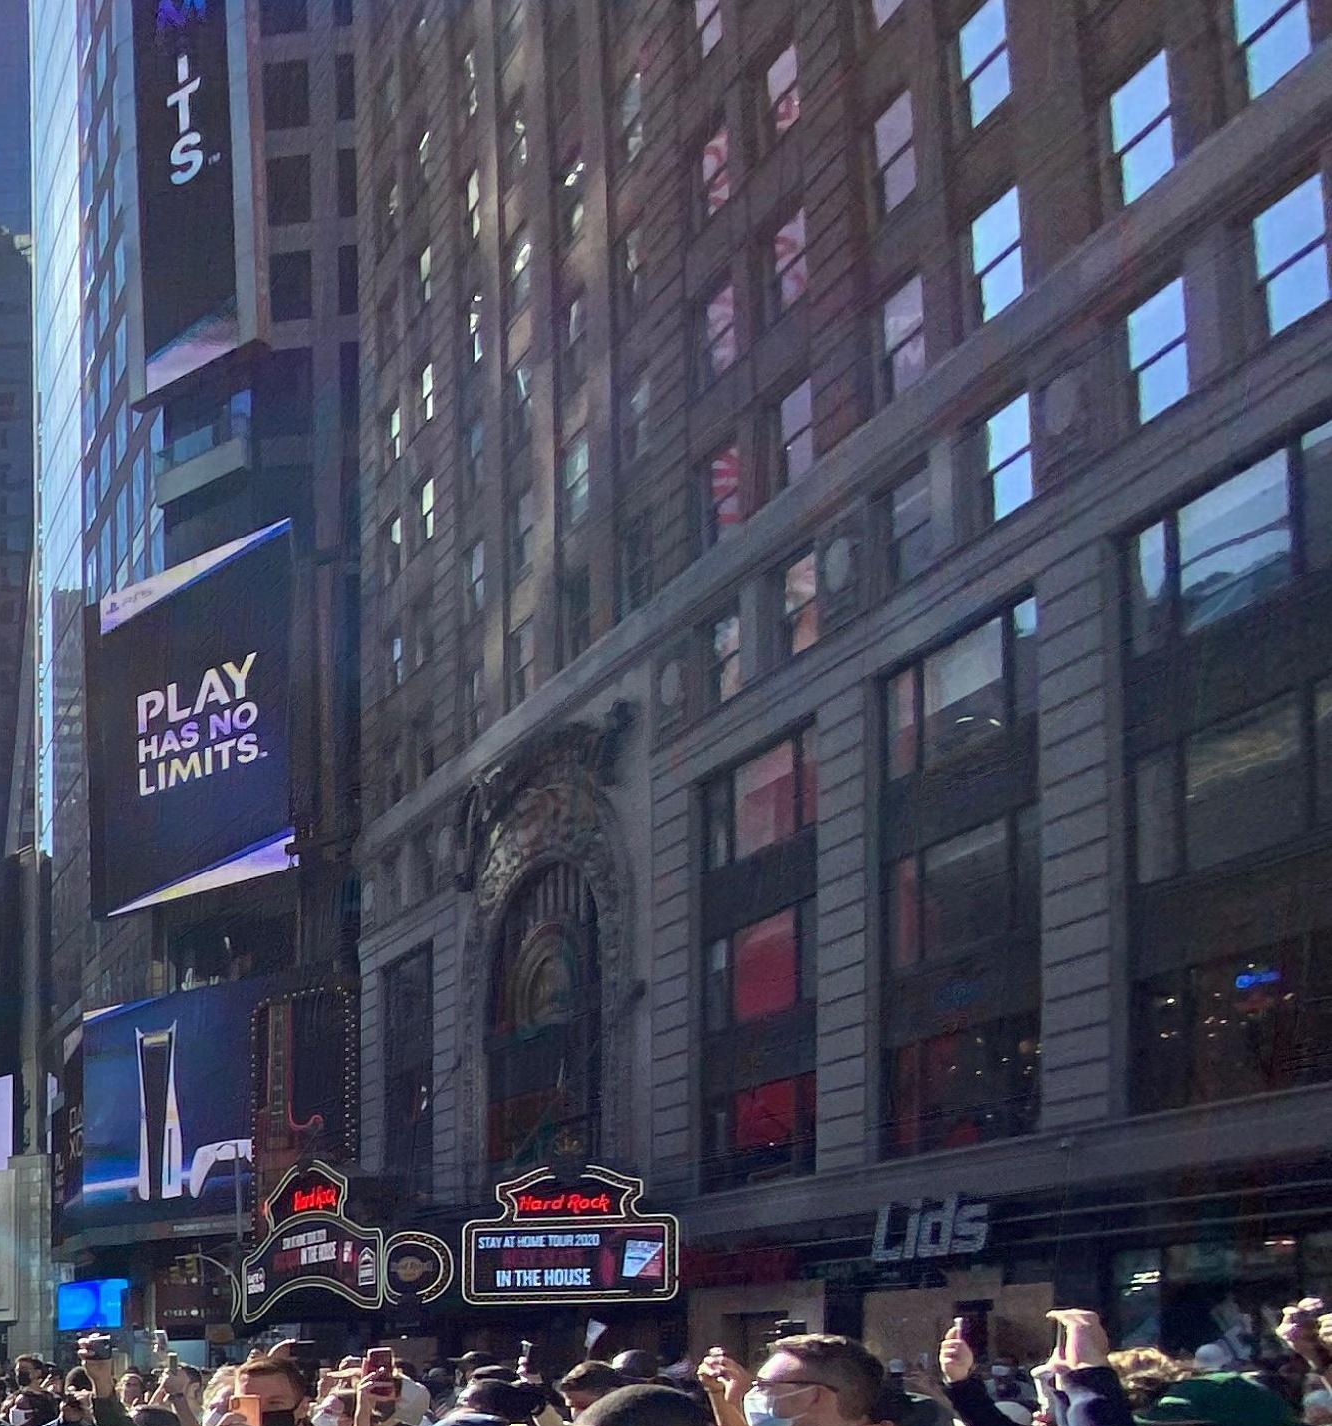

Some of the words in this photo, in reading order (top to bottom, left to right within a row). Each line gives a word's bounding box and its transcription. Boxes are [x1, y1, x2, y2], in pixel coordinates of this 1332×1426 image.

[137, 651, 257, 735] PLAY
[138, 720, 200, 763] HAS
[209, 701, 259, 741] NO
[518, 1193, 565, 1211] Hard
[567, 1192, 611, 1214] Rock
[477, 1236, 503, 1249] STAY
[503, 1236, 516, 1248] AT
[547, 1234, 574, 1247] TOUR
[574, 1233, 600, 1247] 2020
[872, 1192, 989, 1262] Lids
[495, 1269, 512, 1287] IN
[514, 1269, 542, 1287] THE
[544, 1268, 591, 1286] HOUSE
